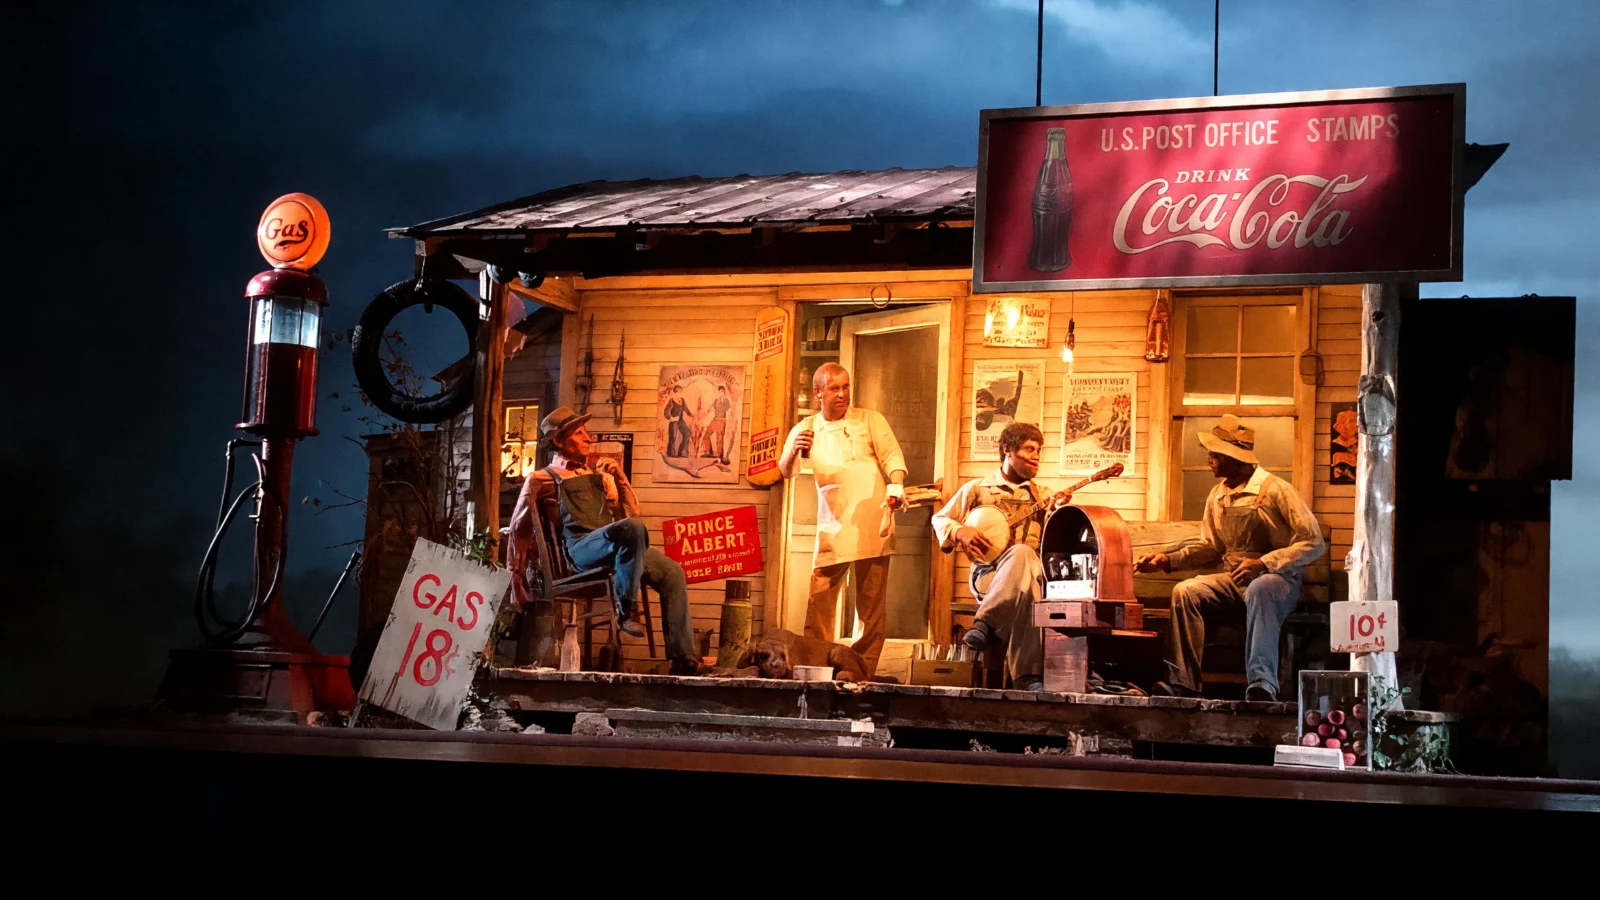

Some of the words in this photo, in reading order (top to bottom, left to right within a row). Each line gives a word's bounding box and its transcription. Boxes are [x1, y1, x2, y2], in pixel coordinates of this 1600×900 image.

[1204, 120, 1279, 147] OFFICE
[1306, 113, 1400, 142] STAMPS
[1175, 168, 1251, 184] DRINK
[265, 218, 309, 249] Gas
[674, 515, 734, 544] PRINCE
[681, 532, 746, 555] ALBERT
[413, 574, 484, 630] GAS
